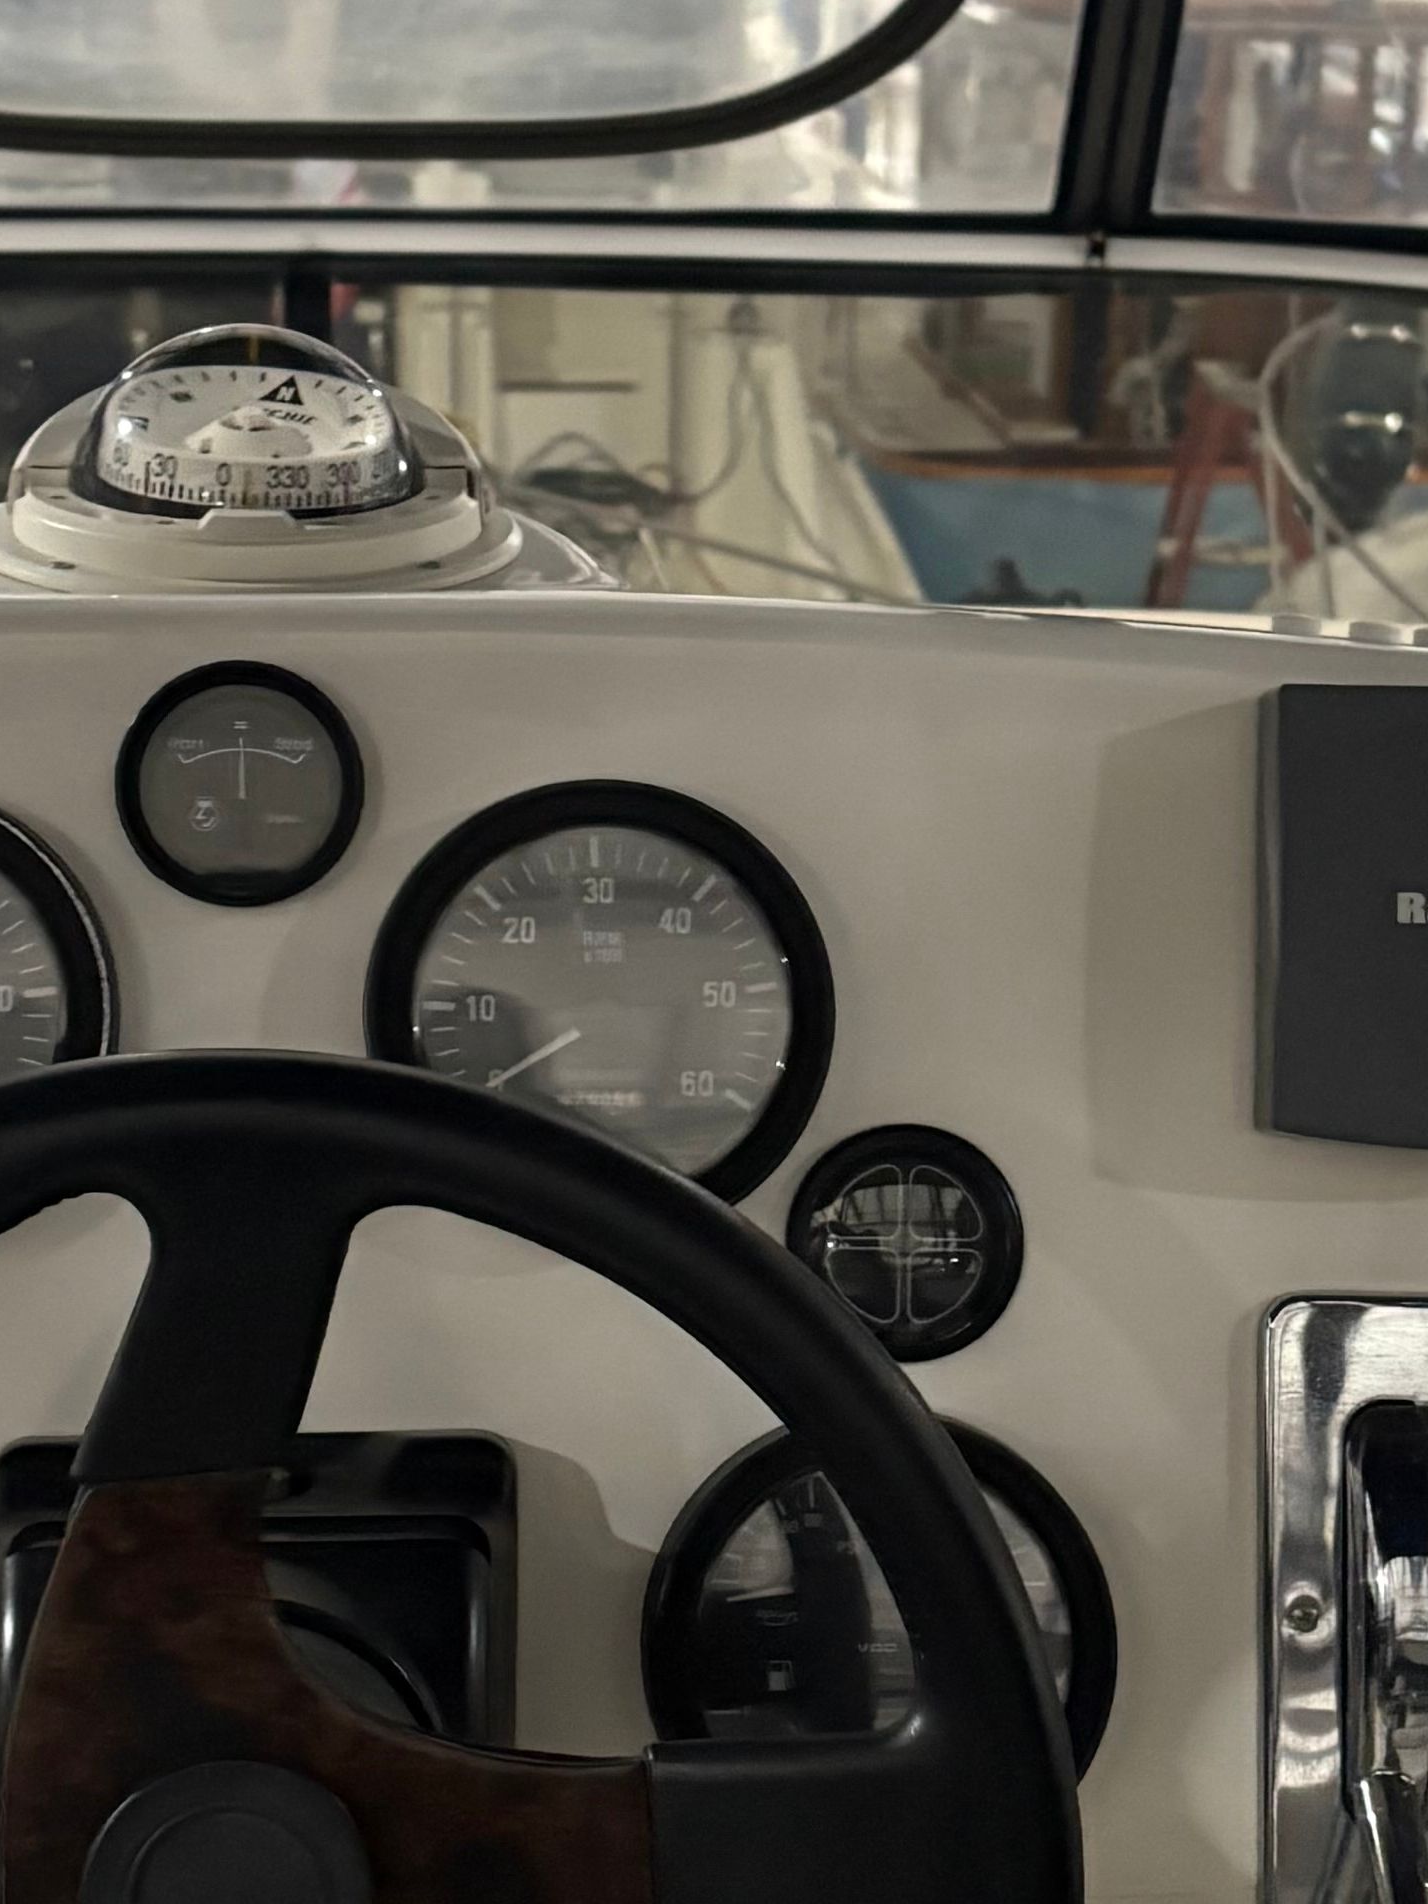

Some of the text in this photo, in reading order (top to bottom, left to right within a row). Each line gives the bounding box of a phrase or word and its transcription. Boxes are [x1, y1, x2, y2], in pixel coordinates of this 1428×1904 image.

[267, 465, 309, 489] 330
[583, 878, 614, 904] 30
[502, 917, 535, 944] 20
[660, 909, 691, 934] 40
[703, 981, 736, 1008] 50
[466, 995, 496, 1021] 10
[680, 1070, 713, 1097] 60
